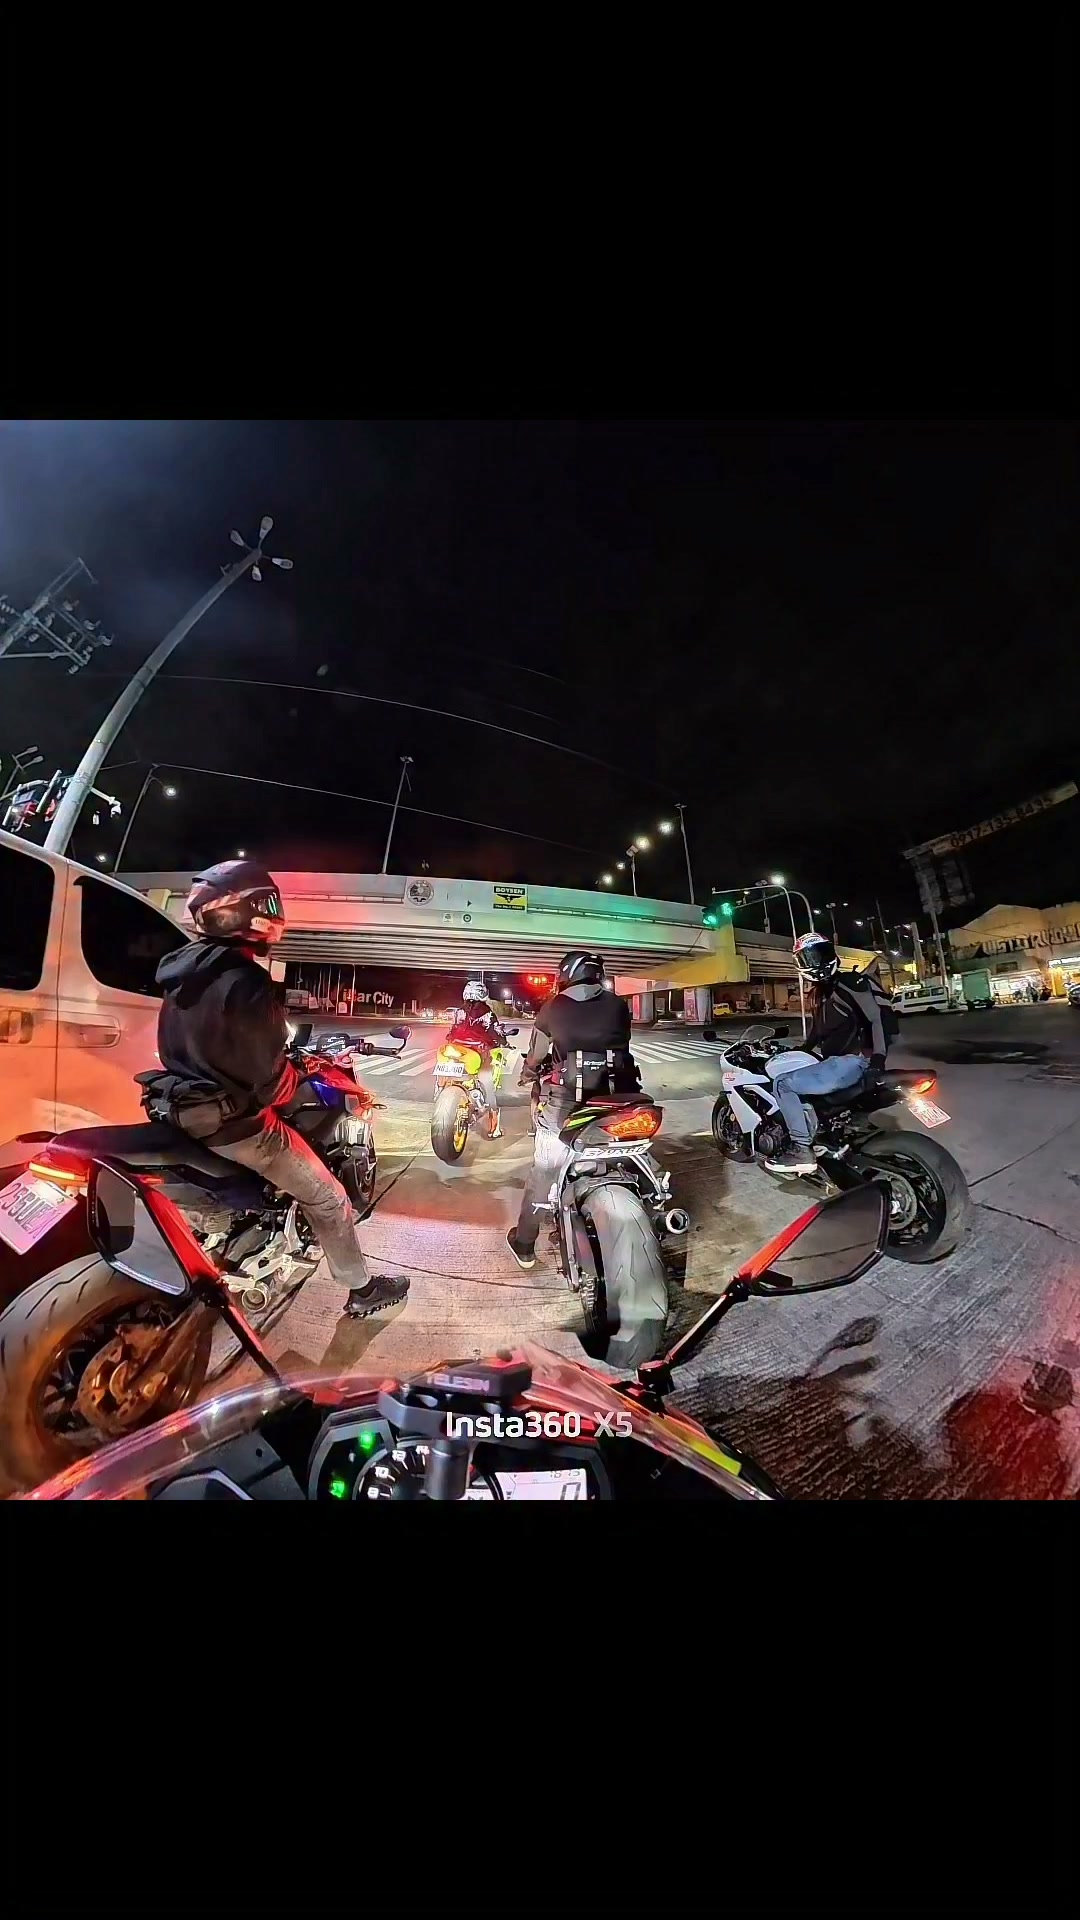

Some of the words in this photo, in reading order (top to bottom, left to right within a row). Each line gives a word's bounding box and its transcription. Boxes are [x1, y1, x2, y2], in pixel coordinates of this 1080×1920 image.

[495, 886, 524, 895] BOYSEN
[372, 991, 395, 1008] City
[427, 1373, 490, 1392] TELESIN
[375, 1466, 390, 1479] 10
